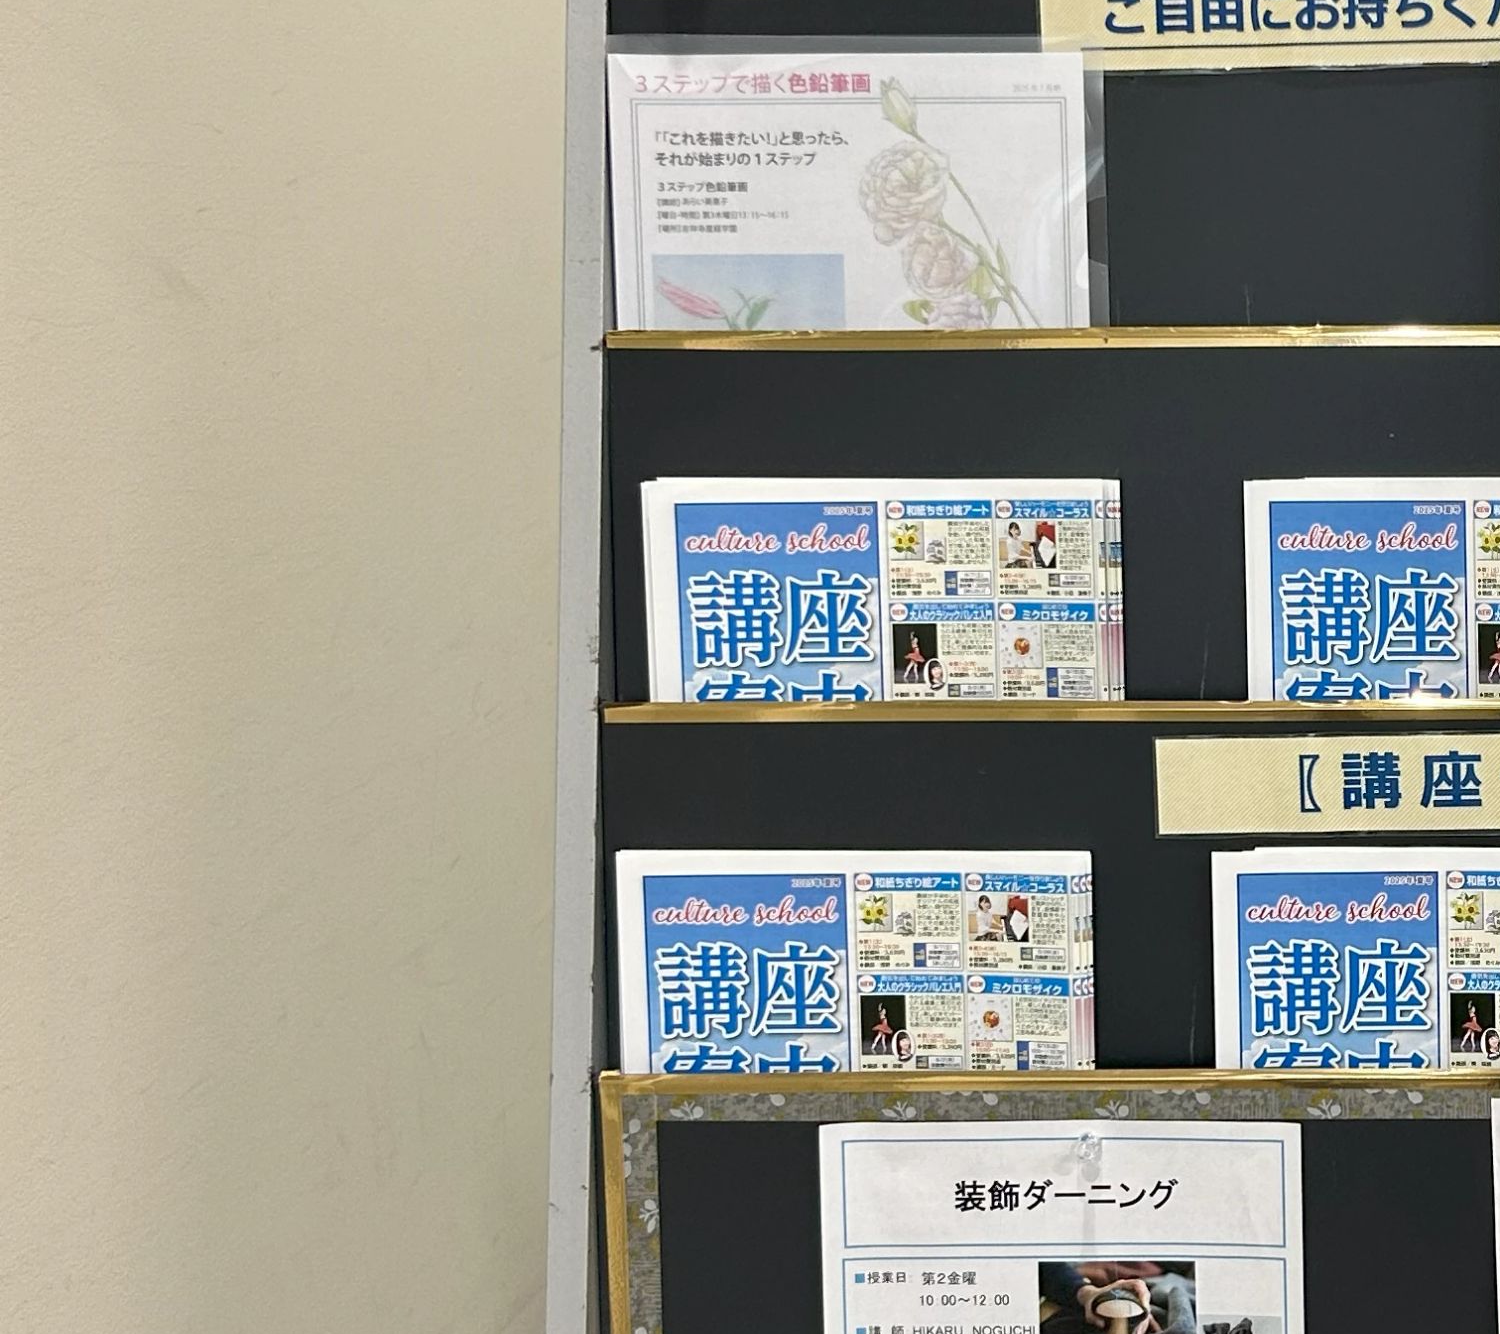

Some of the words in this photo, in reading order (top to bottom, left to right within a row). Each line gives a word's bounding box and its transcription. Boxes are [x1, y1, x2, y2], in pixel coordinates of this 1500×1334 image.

[634, 73, 872, 96] 3ステップで描く色鉛筆画
[654, 150, 818, 167] それが始まりの1ステップ
[686, 529, 779, 555] culture
[788, 524, 869, 555] school
[1277, 528, 1372, 553] culture
[1376, 522, 1458, 552] school
[687, 570, 876, 669] 講座
[1021, 610, 1089, 621] ミクロモザイク
[1280, 569, 1461, 664] 講座
[654, 900, 747, 925] culture
[754, 895, 838, 924] school
[1246, 897, 1341, 924] culture
[1345, 892, 1430, 923] school
[655, 941, 841, 1039] 講座
[992, 983, 1062, 995] ミクロモザイク
[1246, 938, 1434, 1036] 講座
[954, 1178, 1179, 1212] 装飾ダーニング
[922, 1270, 978, 1286] 第2金曜
